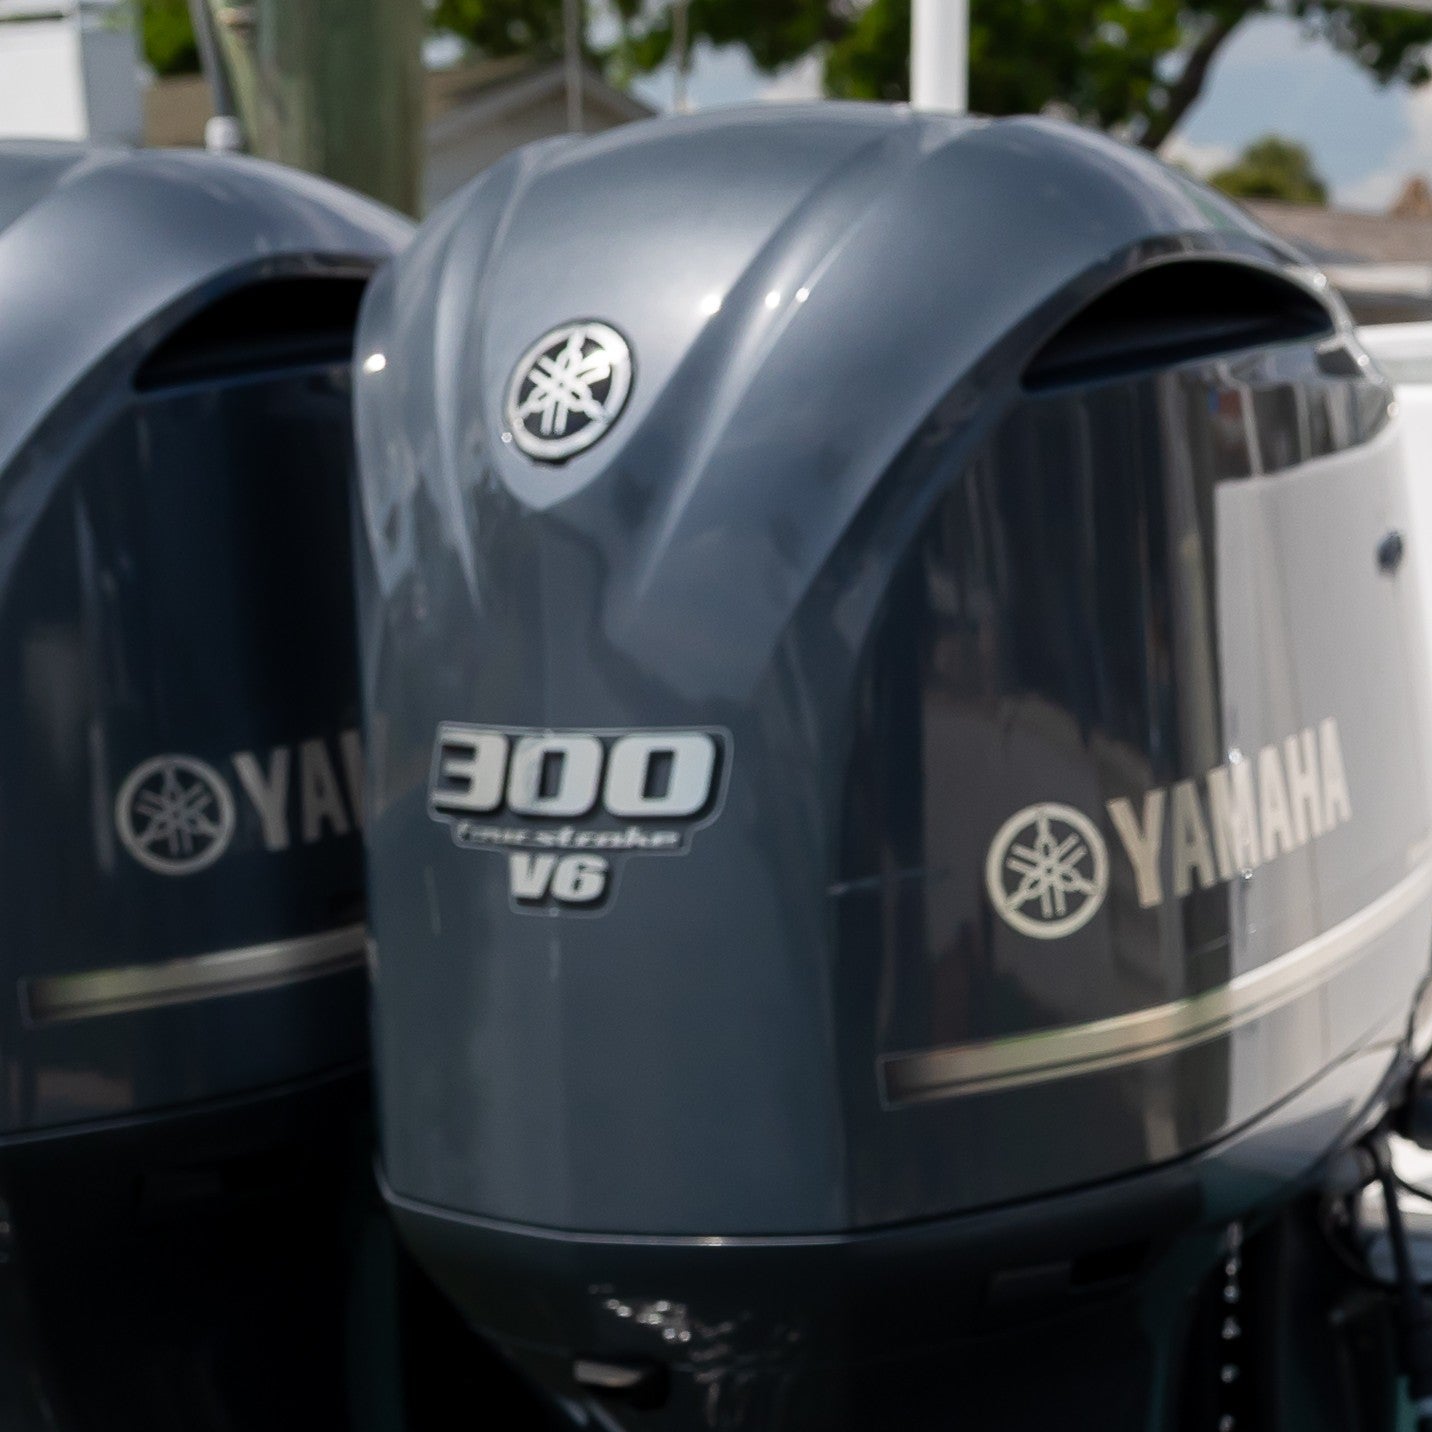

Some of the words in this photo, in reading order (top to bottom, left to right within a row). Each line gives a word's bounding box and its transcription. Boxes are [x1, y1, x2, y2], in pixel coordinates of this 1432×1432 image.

[430, 731, 716, 817] 300
[1106, 716, 1353, 909] YAMAHA
[508, 852, 609, 902] V6
